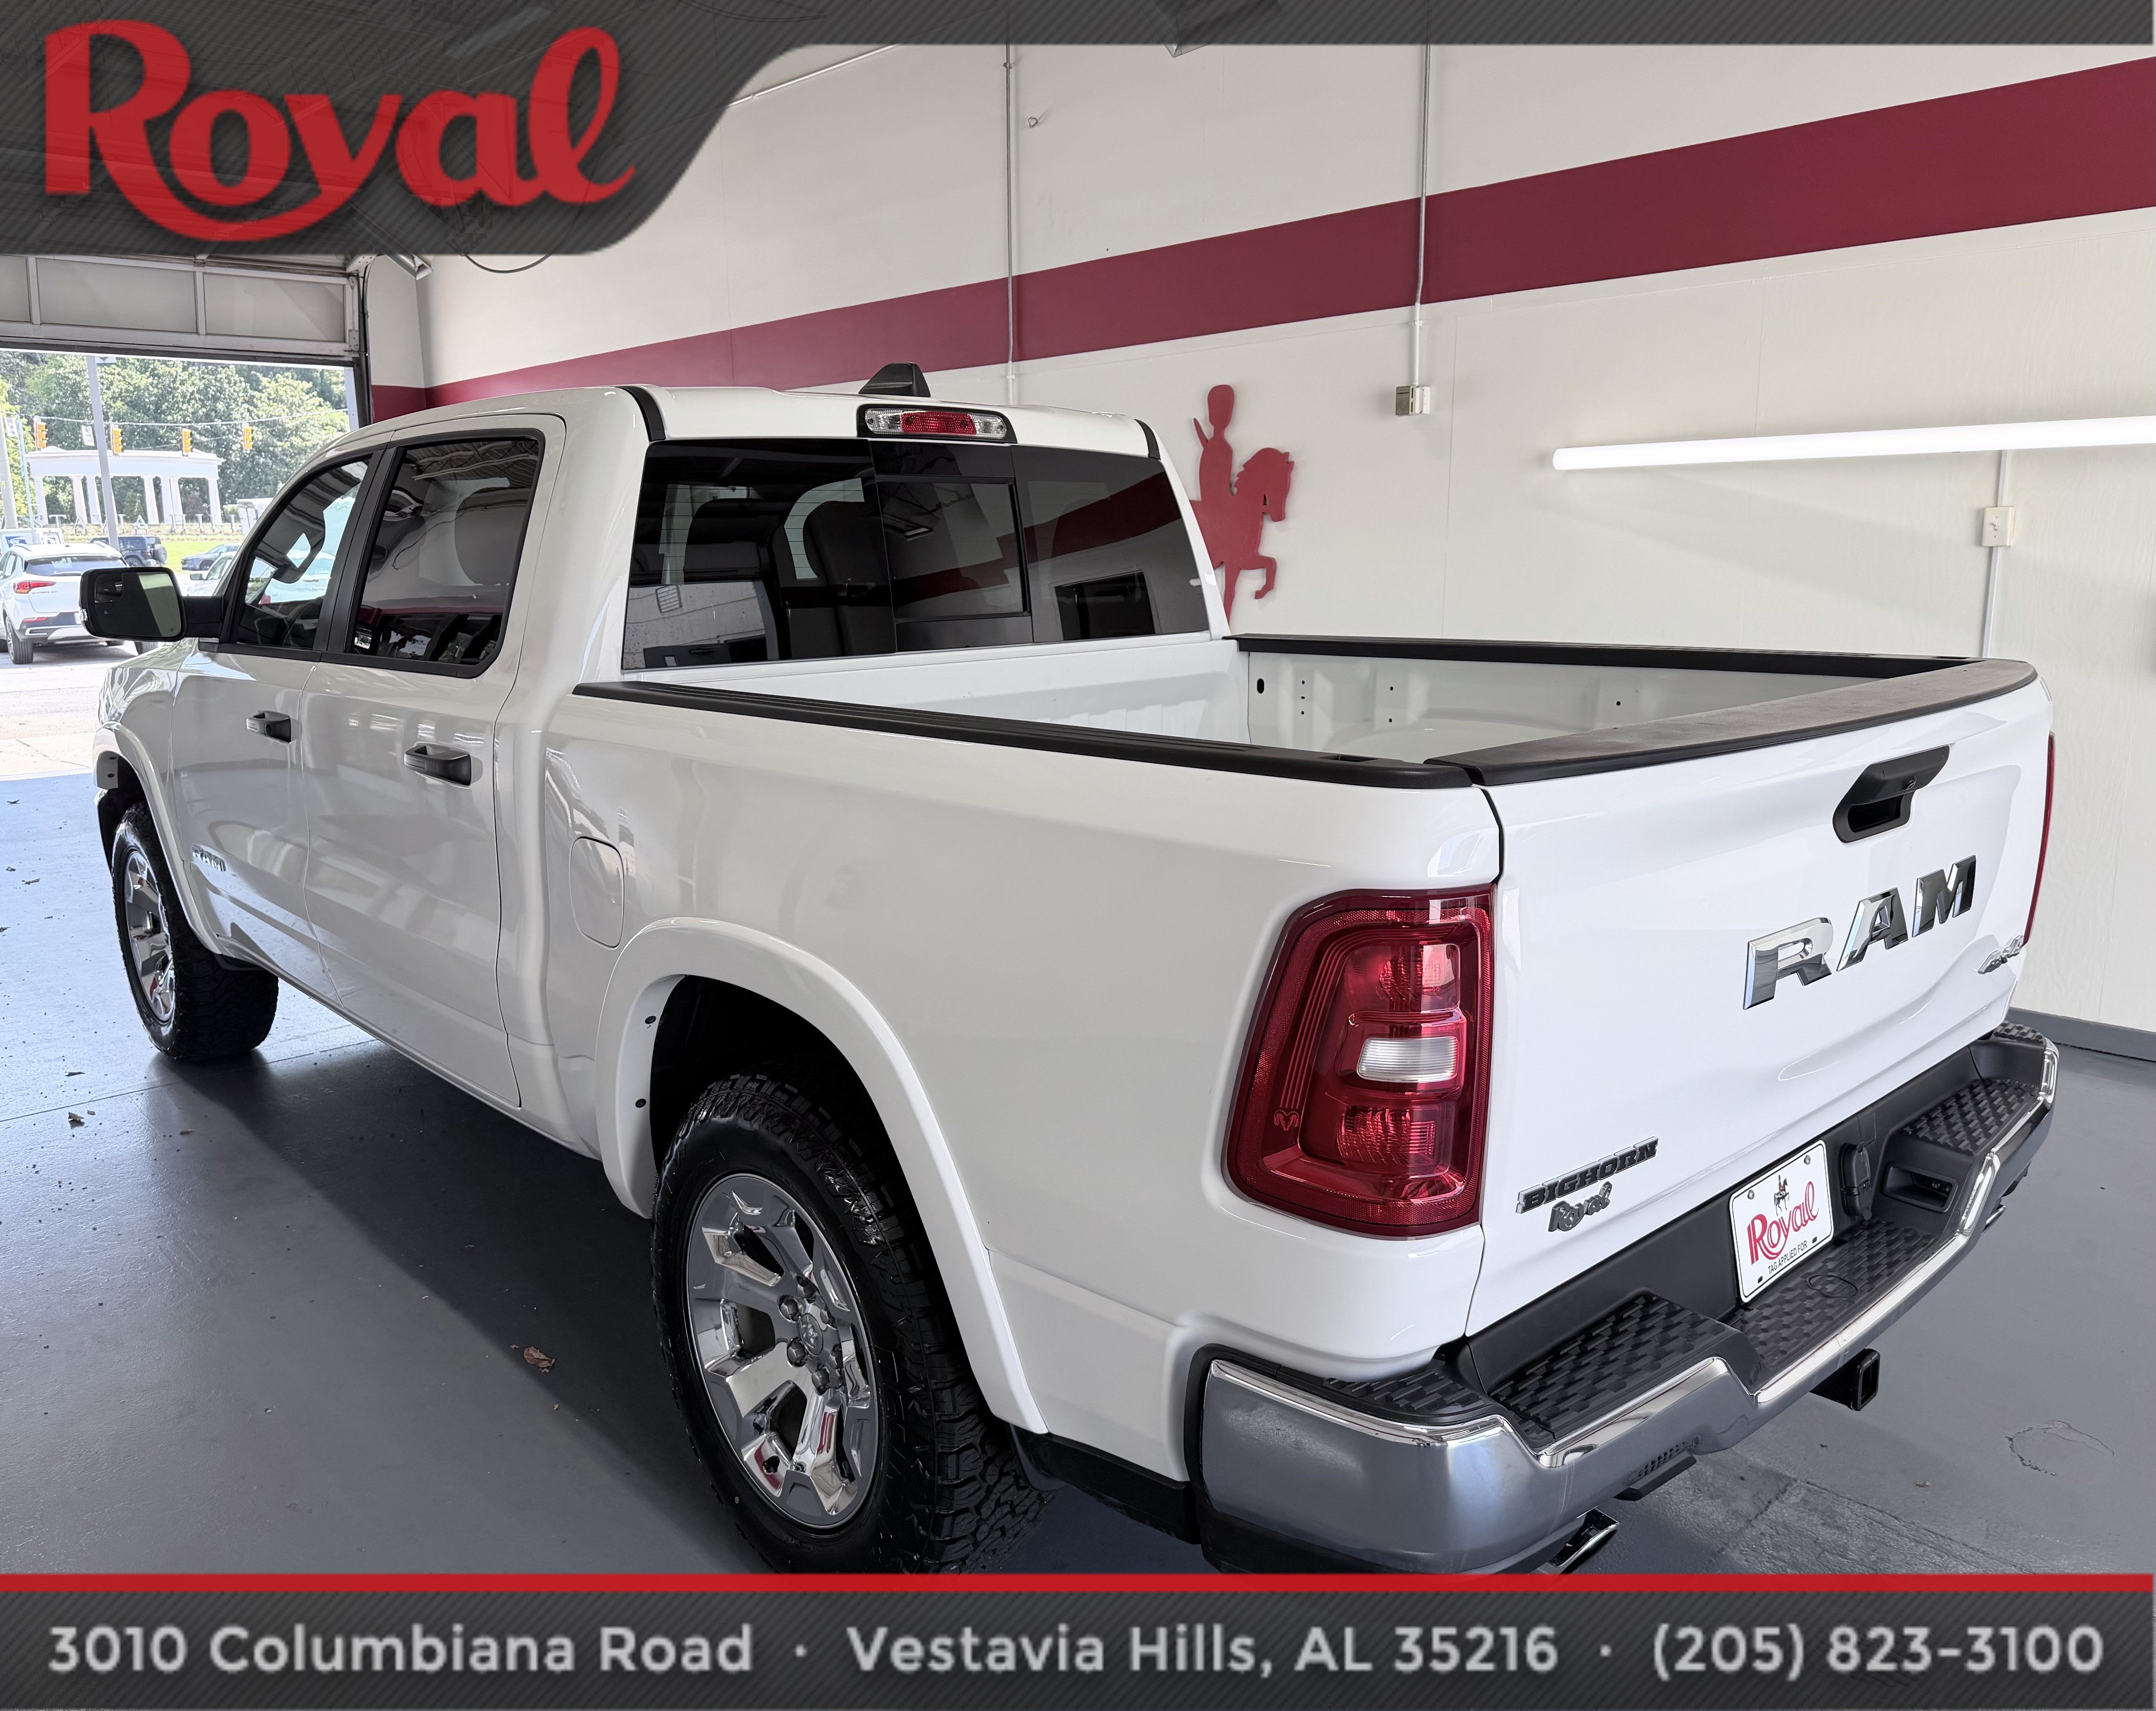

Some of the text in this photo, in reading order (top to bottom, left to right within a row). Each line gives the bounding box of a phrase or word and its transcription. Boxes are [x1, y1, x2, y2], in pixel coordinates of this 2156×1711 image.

[1743, 854, 1976, 1010] RAM
[1516, 1136, 1658, 1214] BIGHORN
[1548, 1181, 1613, 1232] Royal
[1747, 1181, 1819, 1265] Royal
[1768, 1240, 1808, 1274] TAG APPLIED FOR
